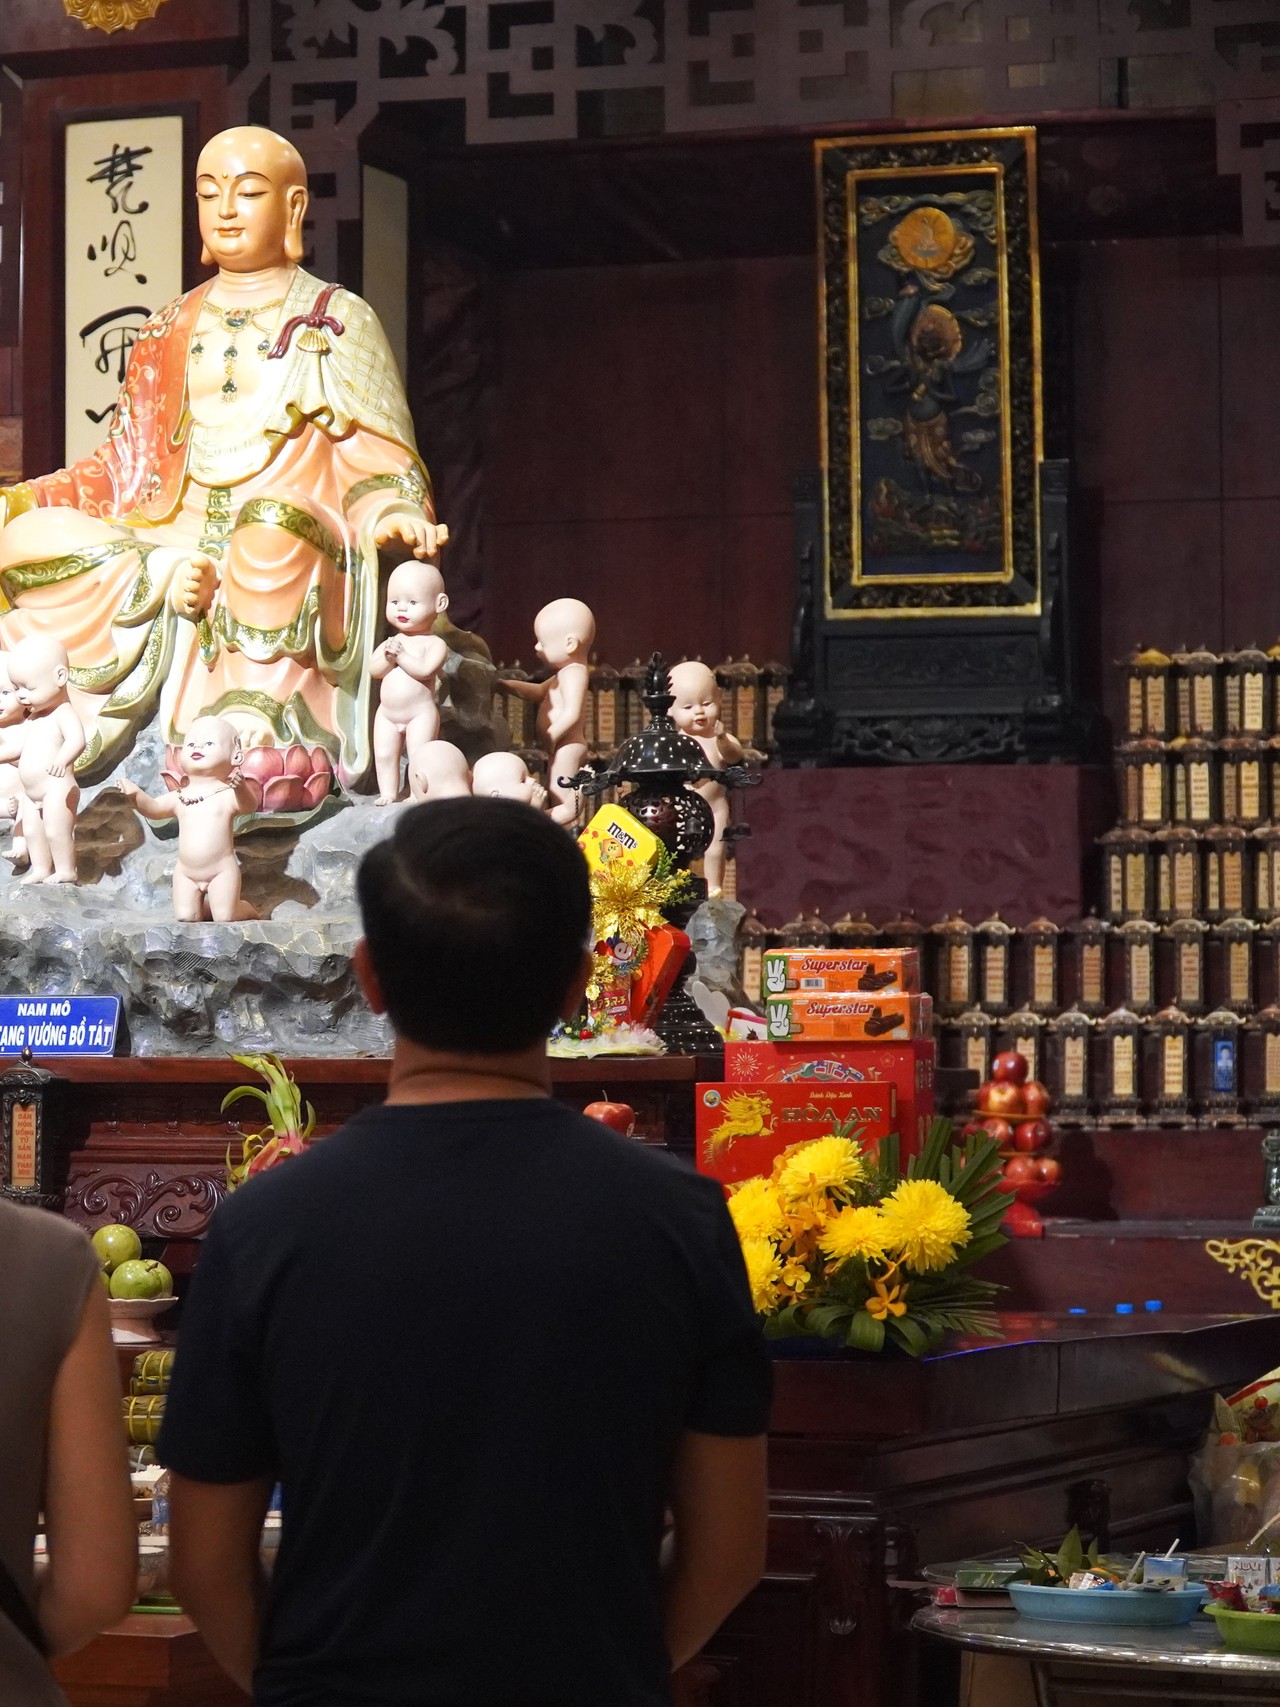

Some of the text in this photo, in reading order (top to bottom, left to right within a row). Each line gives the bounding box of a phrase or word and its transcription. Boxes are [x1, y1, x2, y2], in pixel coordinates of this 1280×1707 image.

[801, 958, 868, 974] Superstar
[17, 1000, 71, 1017] NAM MÔ
[806, 1001, 876, 1018] Superstar
[28, 1022, 66, 1046] VƯƠNG
[69, 1016, 86, 1046] BỒ
[844, 1106, 882, 1122] AN
